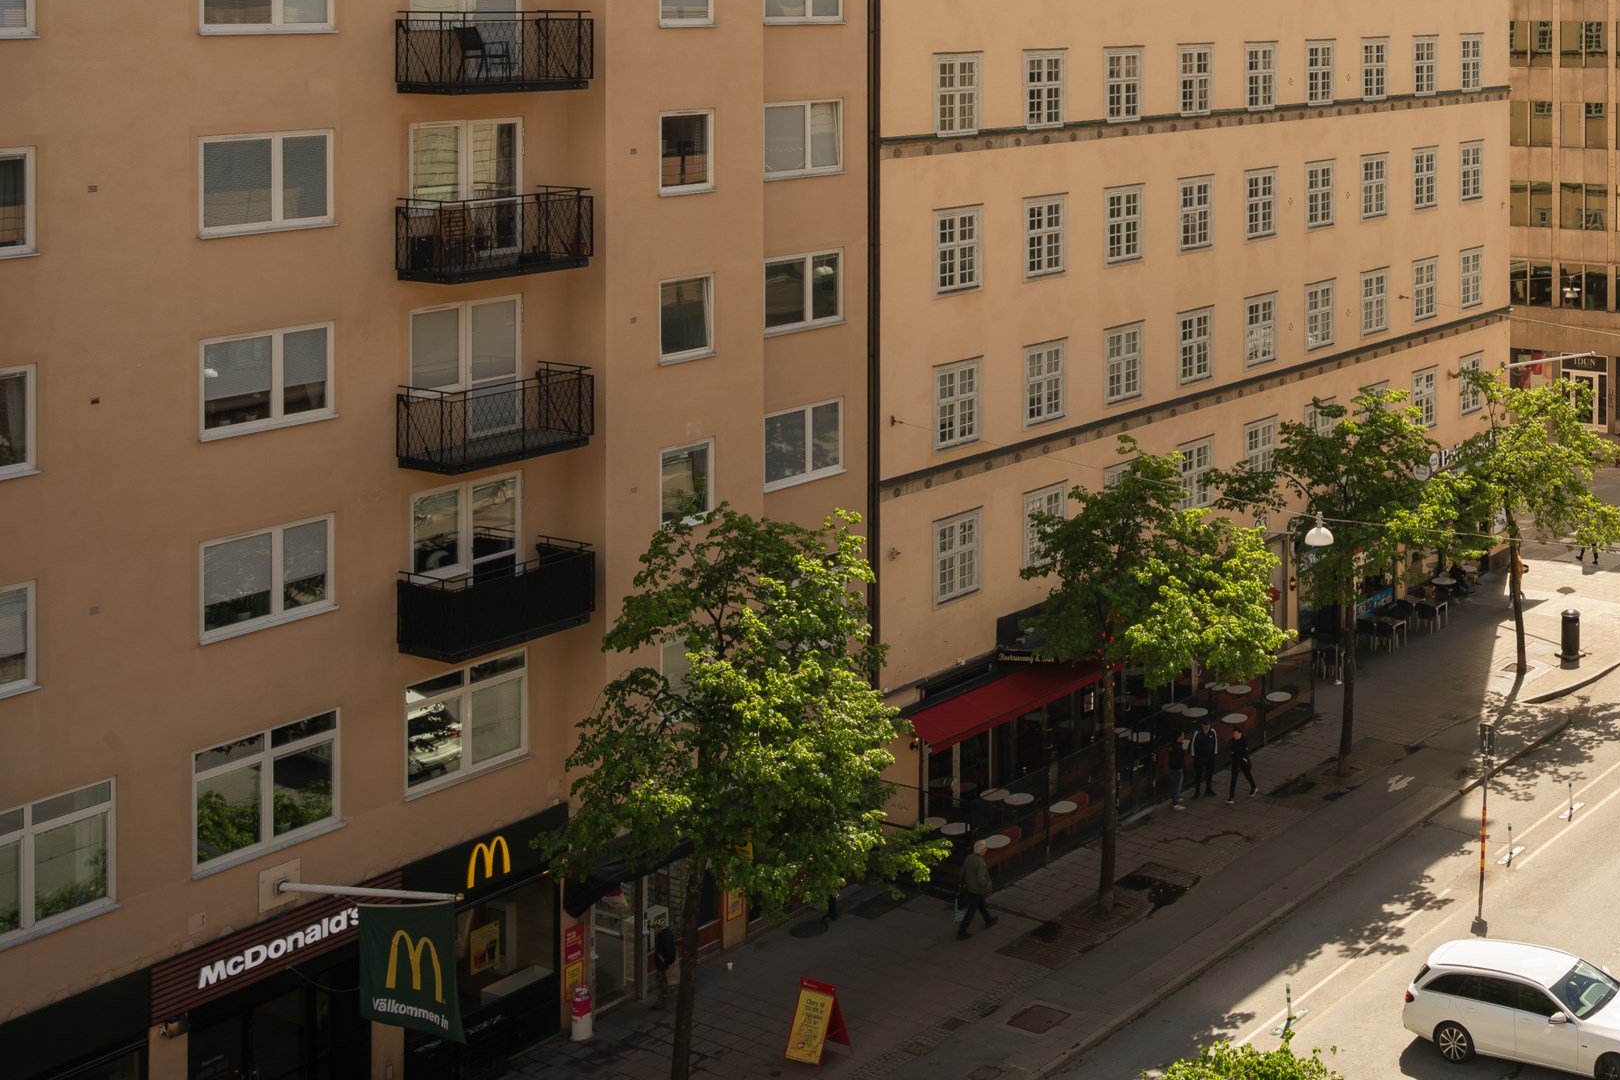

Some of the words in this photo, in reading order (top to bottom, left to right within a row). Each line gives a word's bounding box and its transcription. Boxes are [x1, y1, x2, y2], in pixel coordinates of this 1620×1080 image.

[1573, 357, 1596, 367] IDUN
[197, 906, 359, 990] McDonald's
[372, 997, 441, 1025] Välkommen
[440, 1015, 449, 1031] in
